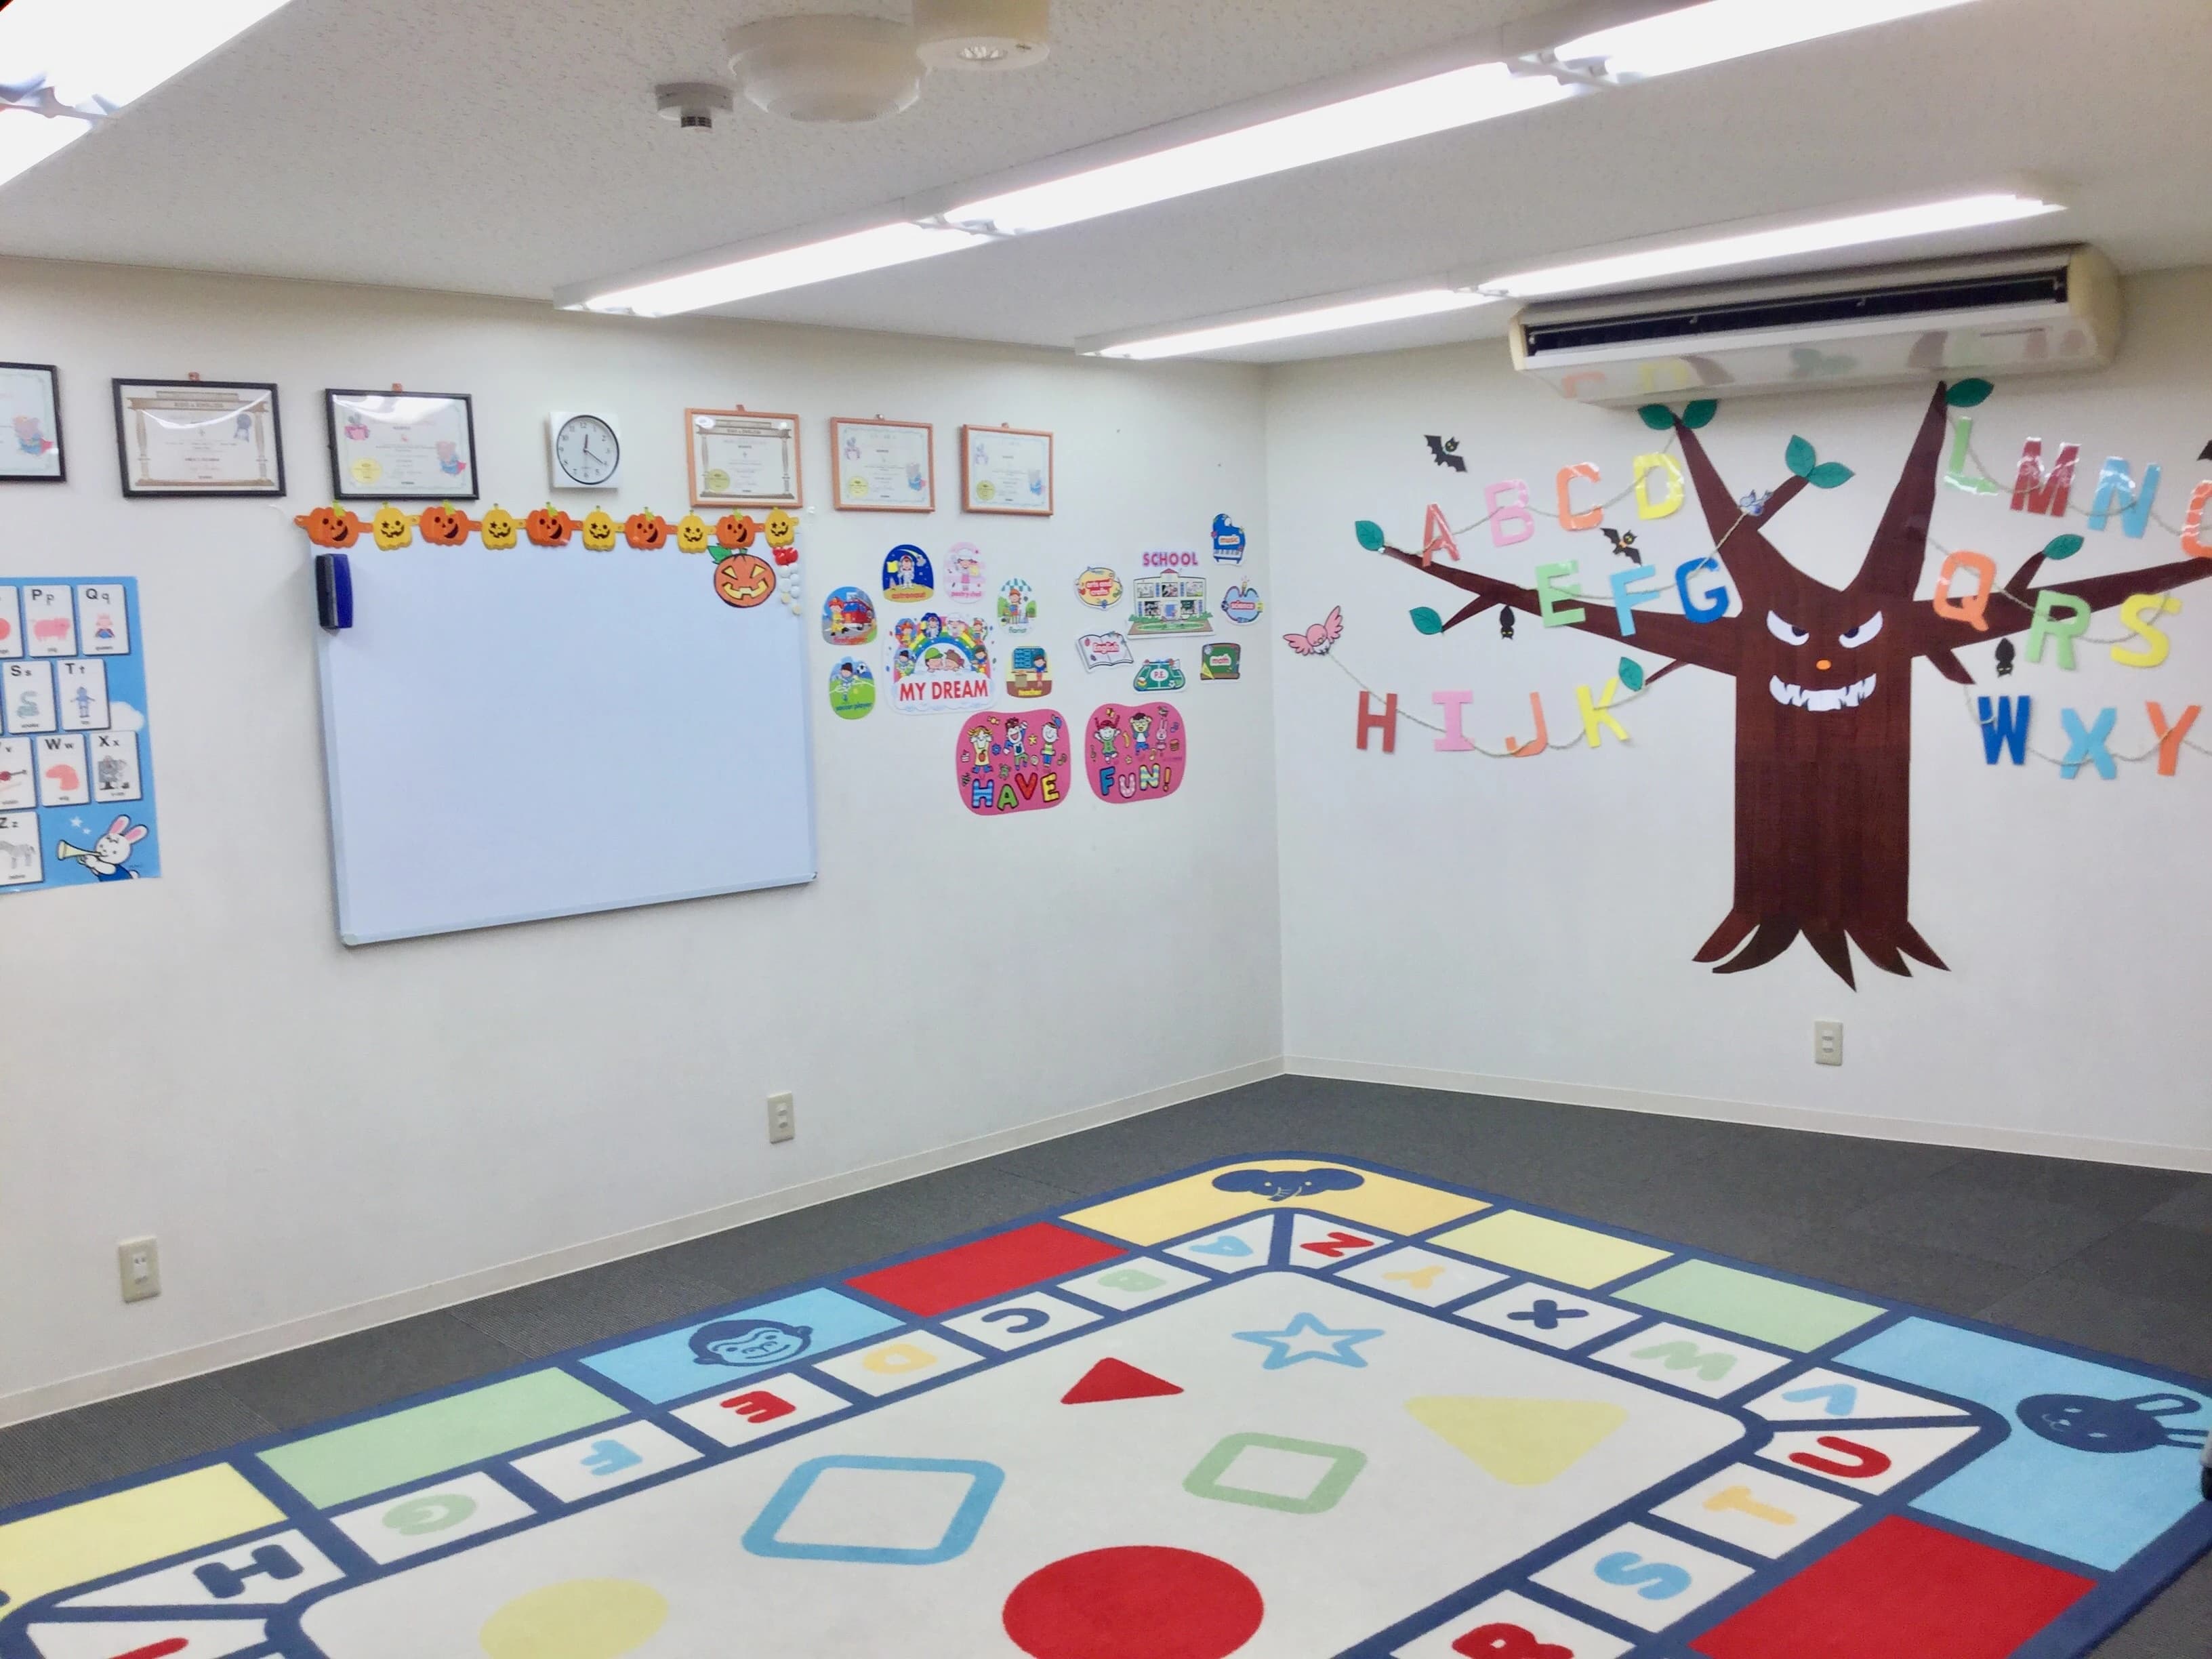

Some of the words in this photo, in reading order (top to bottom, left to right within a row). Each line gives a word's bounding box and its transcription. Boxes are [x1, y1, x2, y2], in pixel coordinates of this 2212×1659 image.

[1944, 416, 1998, 495] L
[2009, 437, 2081, 518] M
[2087, 456, 2162, 539] N
[1422, 504, 1460, 567] A
[1484, 478, 1534, 547] B
[1557, 462, 1603, 532] C
[1633, 452, 1685, 520] D
[1143, 552, 1198, 567] SCHOOL
[1536, 560, 1586, 628] E
[1610, 565, 1660, 636] F
[1675, 557, 1729, 623] G
[1933, 550, 1996, 632] Q
[2025, 590, 2091, 671] R
[2109, 592, 2183, 668] S
[900, 682, 926, 701] MY
[931, 680, 988, 699] DREAM
[1357, 691, 1397, 753] H
[1432, 690, 1474, 752] I
[1505, 691, 1547, 758] J
[1576, 676, 1629, 748] K
[1978, 695, 2030, 765] W
[2061, 708, 2117, 779] X
[2145, 701, 2202, 777] Y
[971, 772, 1060, 811] HAVE
[1099, 763, 1172, 798] FUN!
[1189, 1235, 1254, 1258] A
[1097, 1269, 1167, 1292] B
[981, 1307, 1050, 1334] C
[1382, 1265, 1446, 1289] Y
[1507, 1299, 1590, 1330] X
[1782, 1383, 1858, 1416] V
[720, 1390, 797, 1423] E
[580, 1439, 642, 1475] F
[1789, 1436, 1891, 1478] U
[382, 1494, 477, 1536] G
[1702, 1486, 1797, 1525] T
[192, 1544, 304, 1599] H
[1594, 1551, 1692, 1600] S
